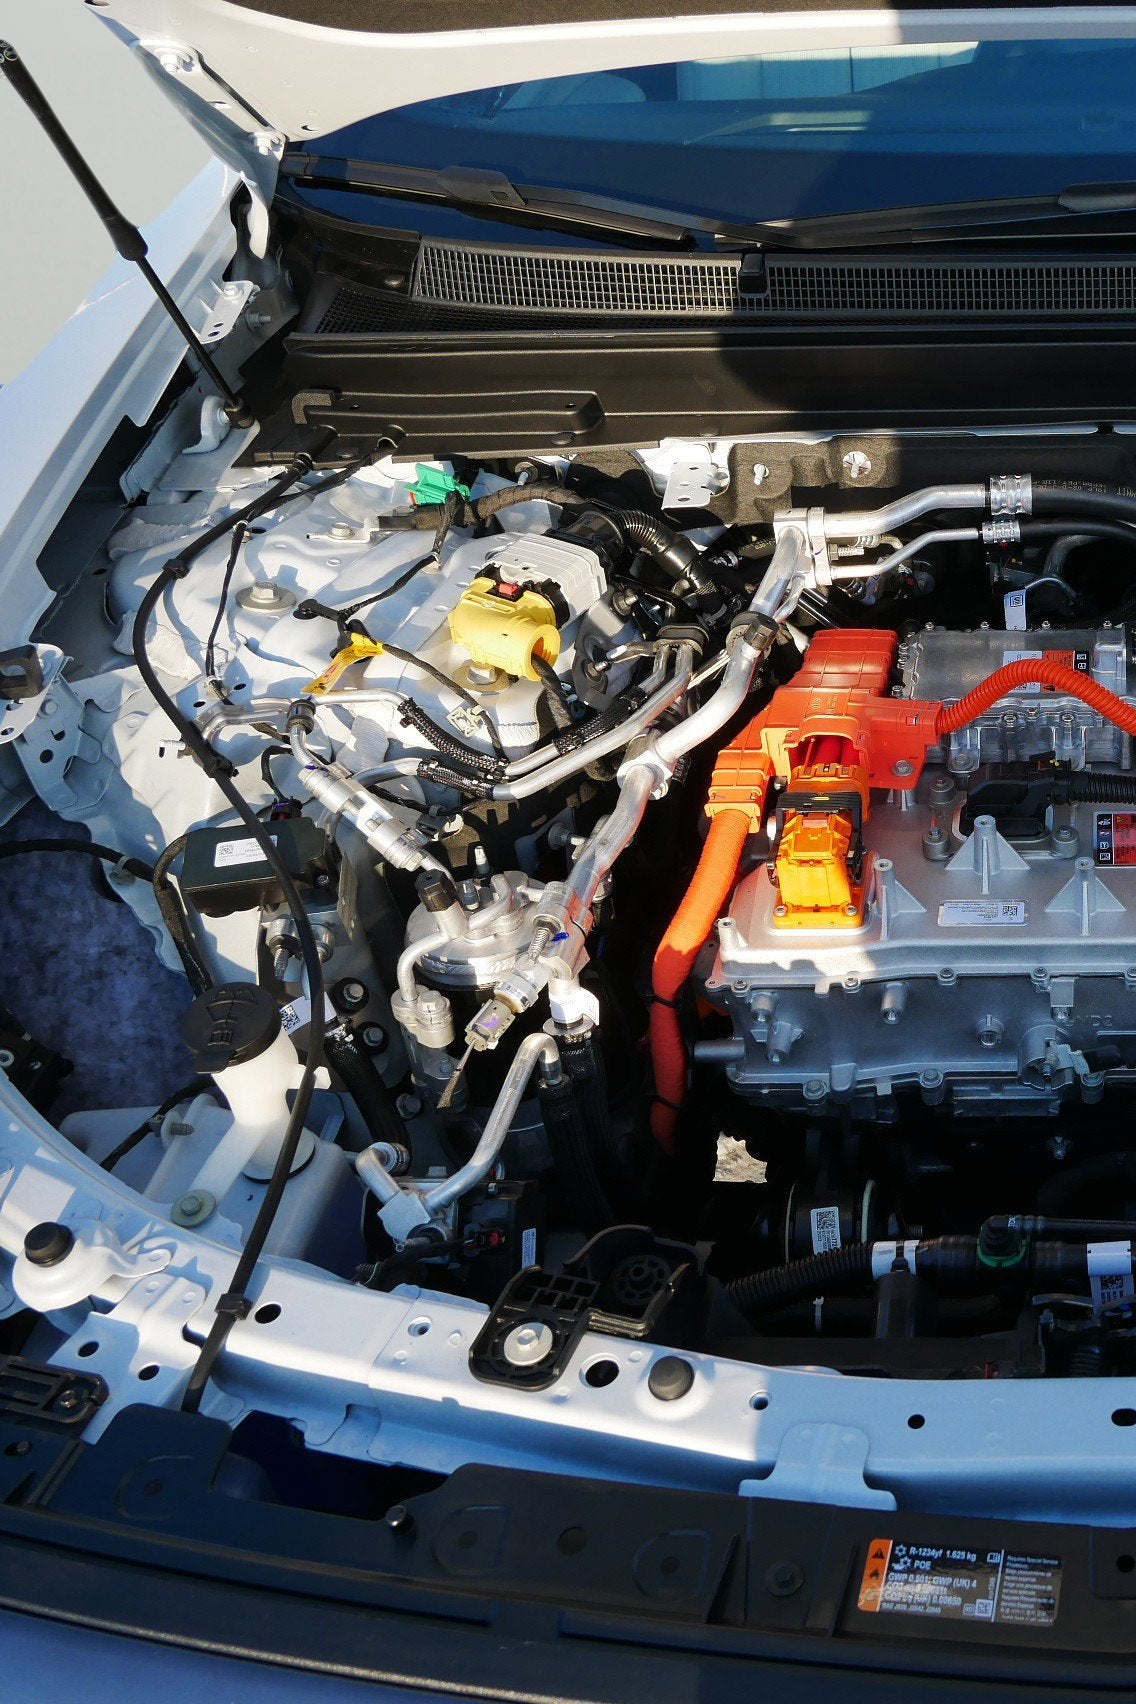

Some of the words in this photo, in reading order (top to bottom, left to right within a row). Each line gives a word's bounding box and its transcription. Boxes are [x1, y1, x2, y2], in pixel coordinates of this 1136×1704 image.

[909, 1546, 942, 1559] R-1234yf
[946, 1549, 965, 1560] 1.625
[966, 1551, 977, 1562] kg
[914, 1559, 931, 1570] POE
[888, 1573, 908, 1583] GWP
[932, 1576, 952, 1586] GWP
[953, 1577, 971, 1589] (UK)
[971, 1579, 977, 1588] 4
